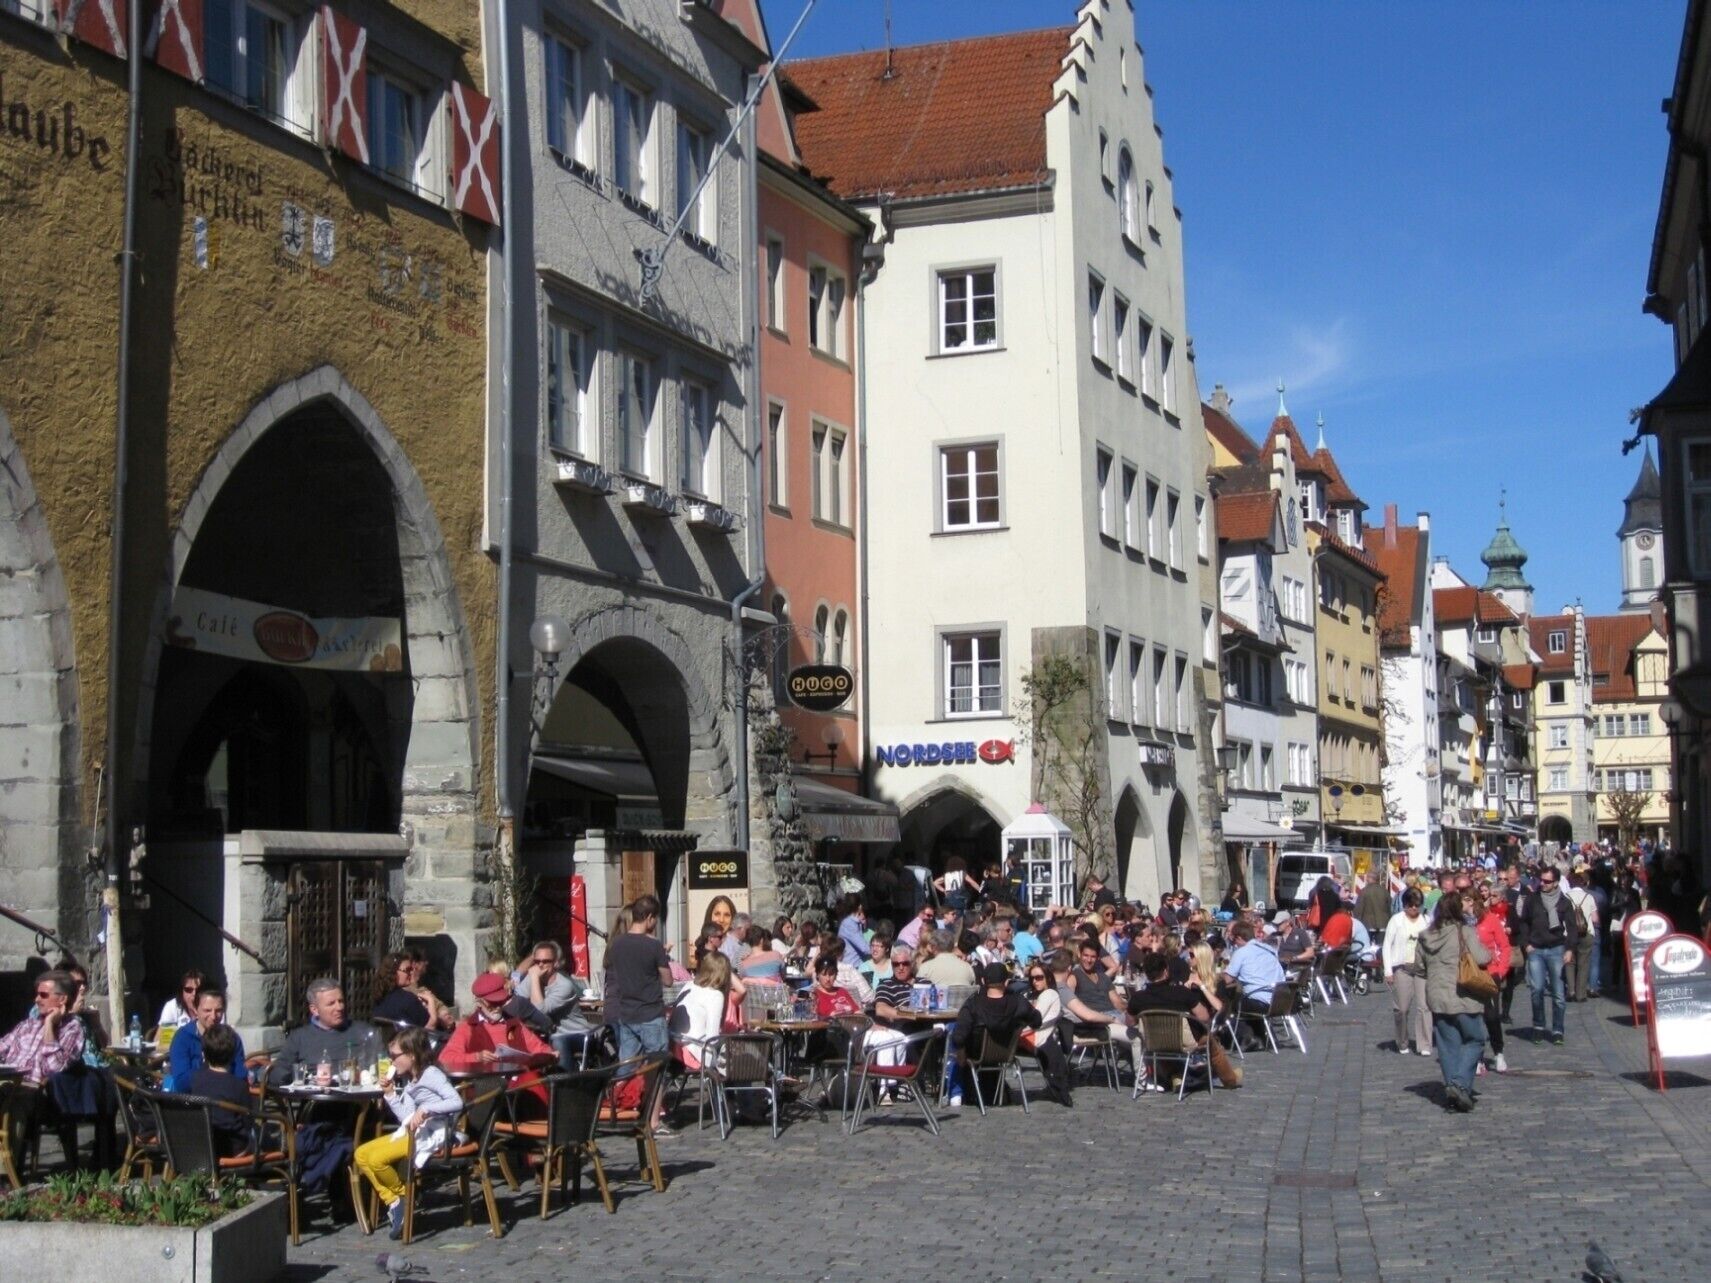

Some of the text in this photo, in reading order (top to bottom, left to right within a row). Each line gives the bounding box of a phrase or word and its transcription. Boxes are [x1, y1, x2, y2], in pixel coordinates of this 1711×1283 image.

[0, 100, 111, 173] aube
[196, 611, 238, 637] Café
[792, 676, 848, 692] HUGO
[876, 742, 977, 768] NORDSEE
[699, 862, 738, 873] HUGO
[1660, 946, 1699, 966] Segafredo
